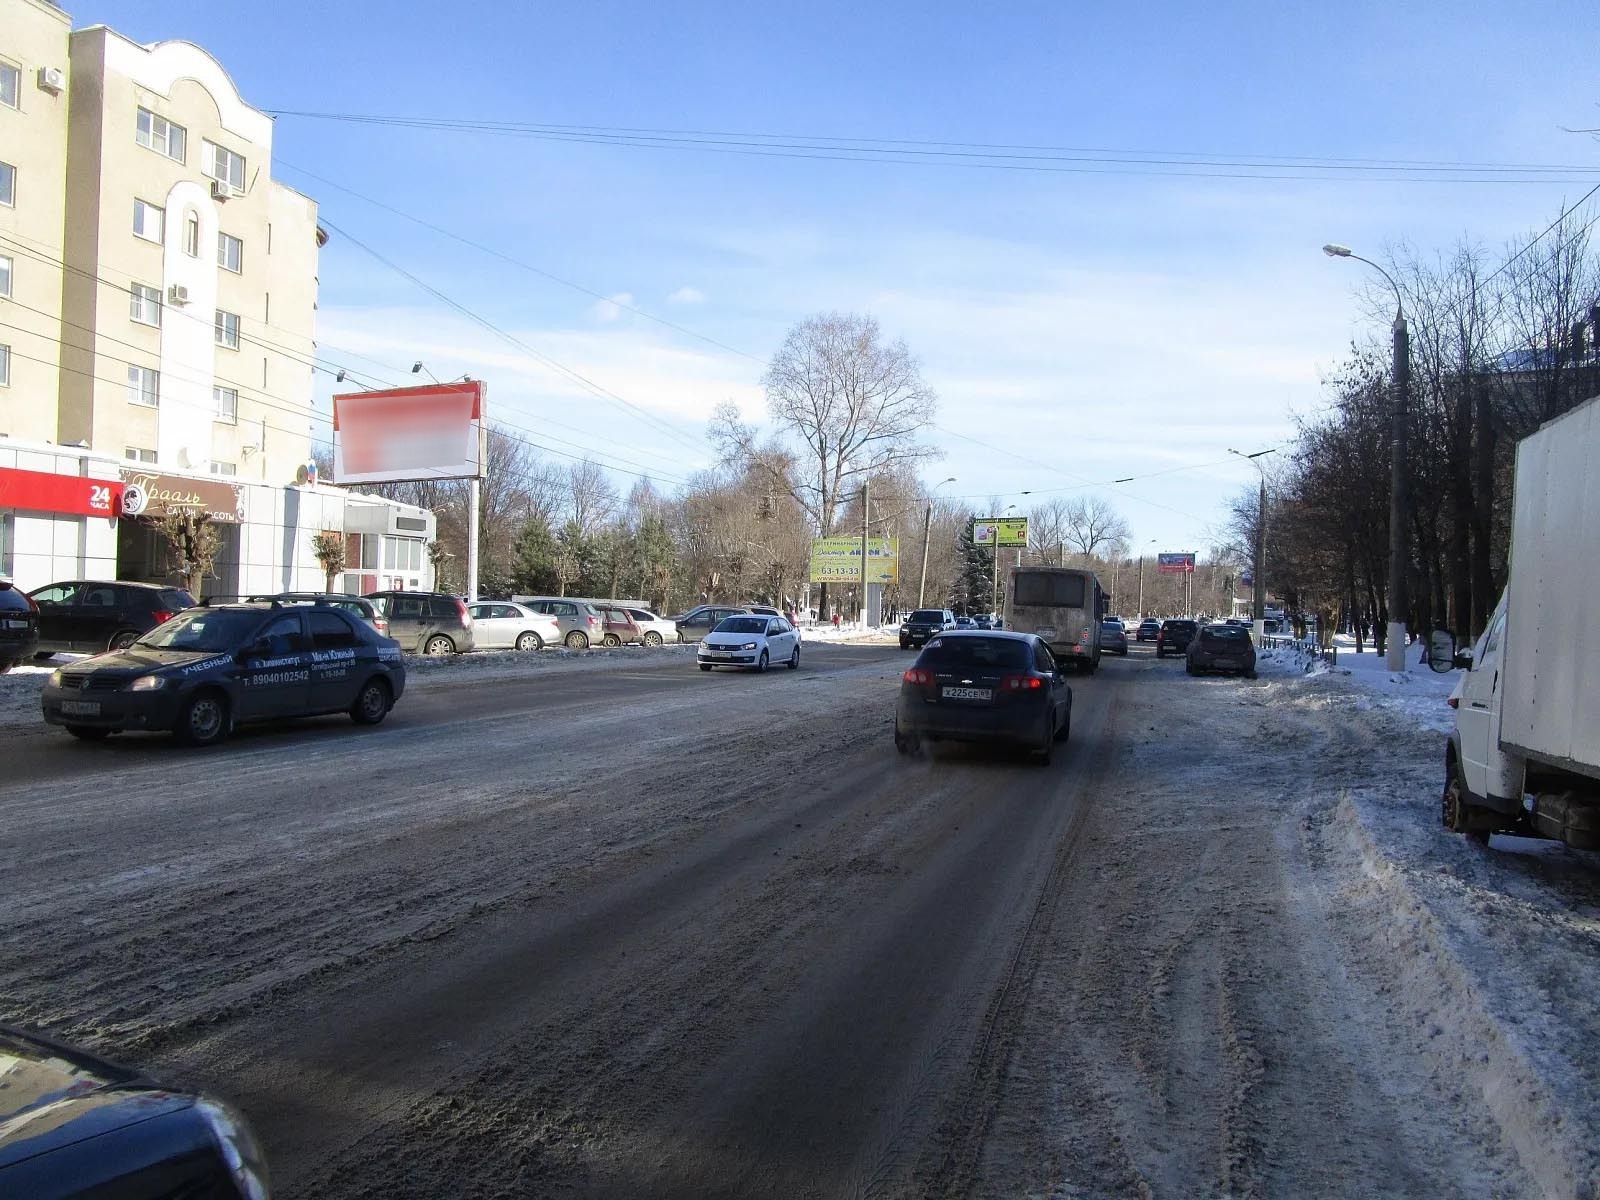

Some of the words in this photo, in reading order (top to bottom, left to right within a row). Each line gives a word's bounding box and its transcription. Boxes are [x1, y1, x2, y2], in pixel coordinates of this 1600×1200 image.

[90, 485, 110, 502] 24
[821, 567, 859, 575] 63-13-33
[329, 648, 355, 660] Южный
[181, 655, 233, 676] УЧЕБНЫЙ
[253, 670, 309, 685] 89040102542
